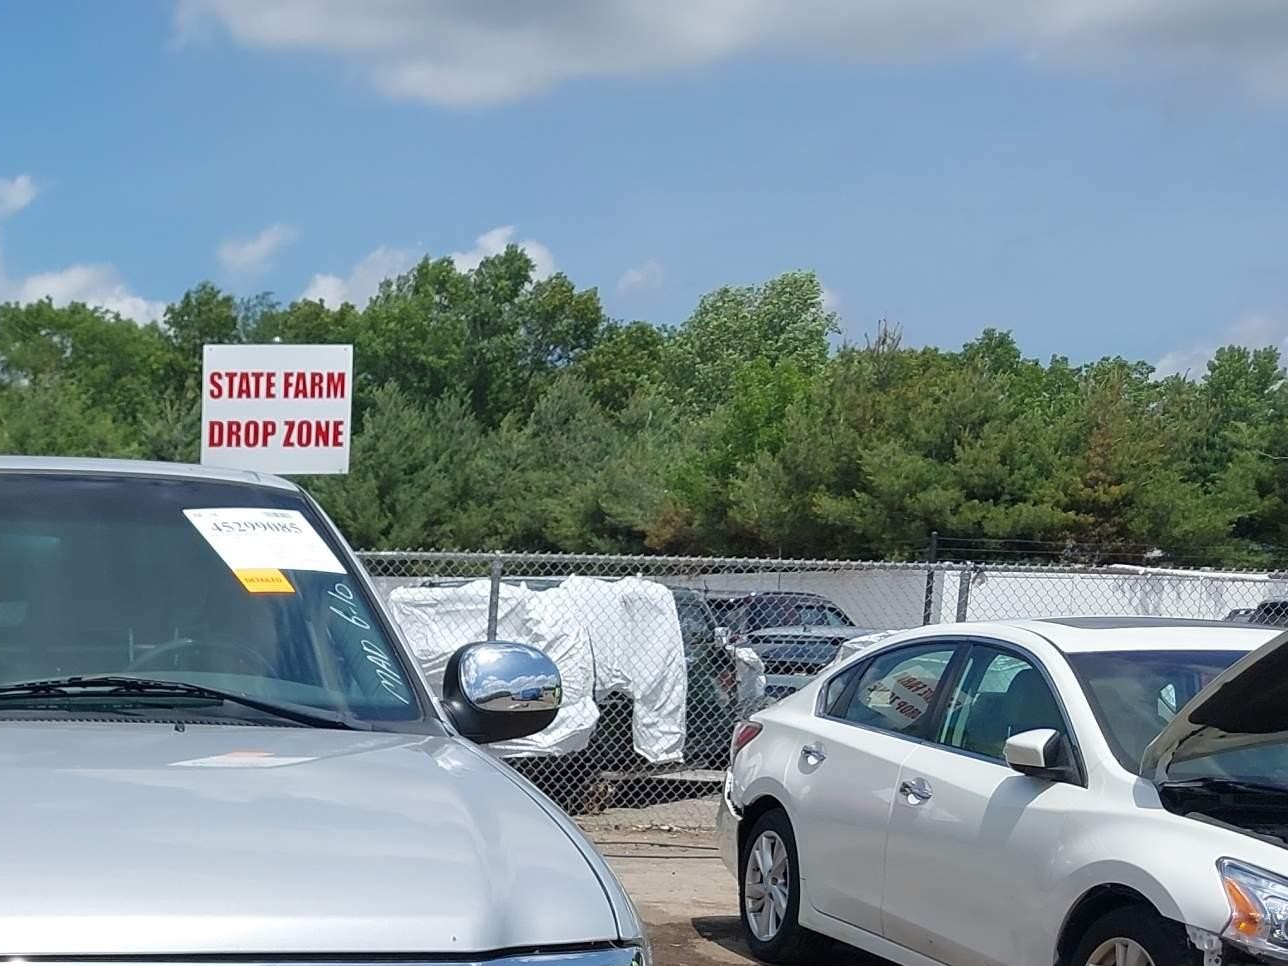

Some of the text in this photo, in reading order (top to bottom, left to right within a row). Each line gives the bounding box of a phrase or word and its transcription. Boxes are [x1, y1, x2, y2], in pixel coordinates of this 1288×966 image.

[209, 371, 346, 399] STATE FARM
[208, 420, 344, 447] DROP ZONE
